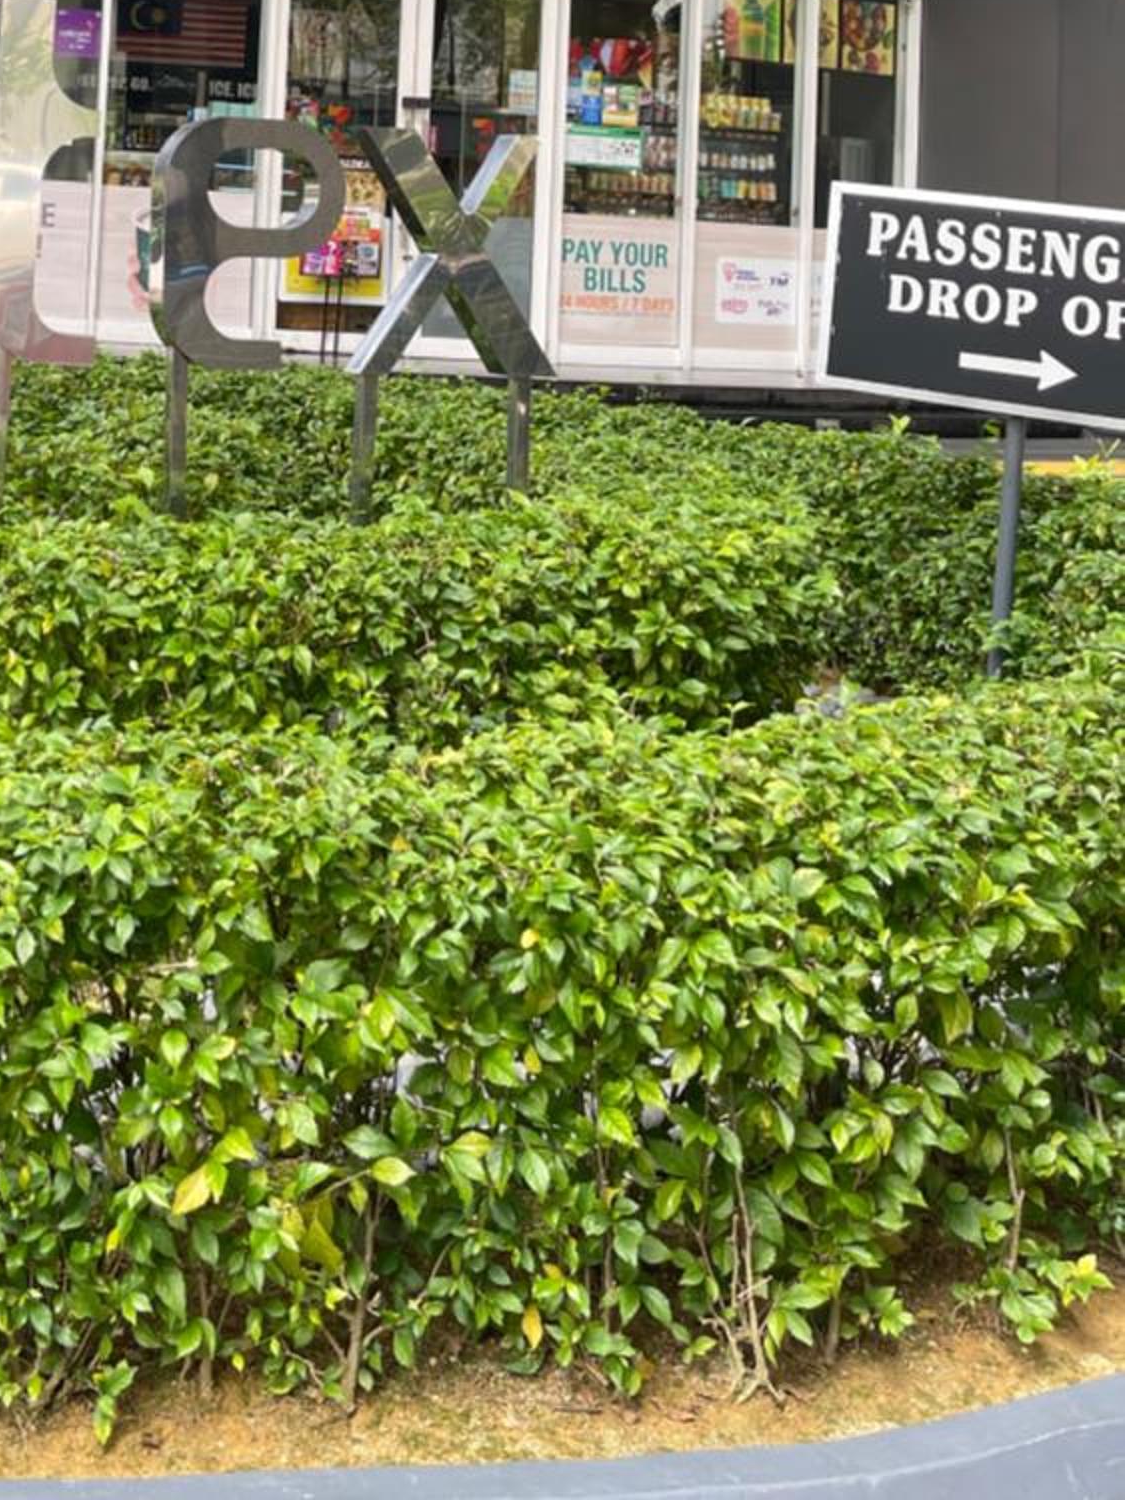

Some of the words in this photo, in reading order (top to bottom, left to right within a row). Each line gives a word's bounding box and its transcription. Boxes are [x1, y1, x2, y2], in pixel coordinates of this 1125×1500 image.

[561, 238, 603, 263] PAY
[609, 240, 668, 268] YOUR
[866, 211, 1125, 284] PASSENG
[583, 266, 646, 293] BILLS
[887, 273, 1038, 327] DROP
